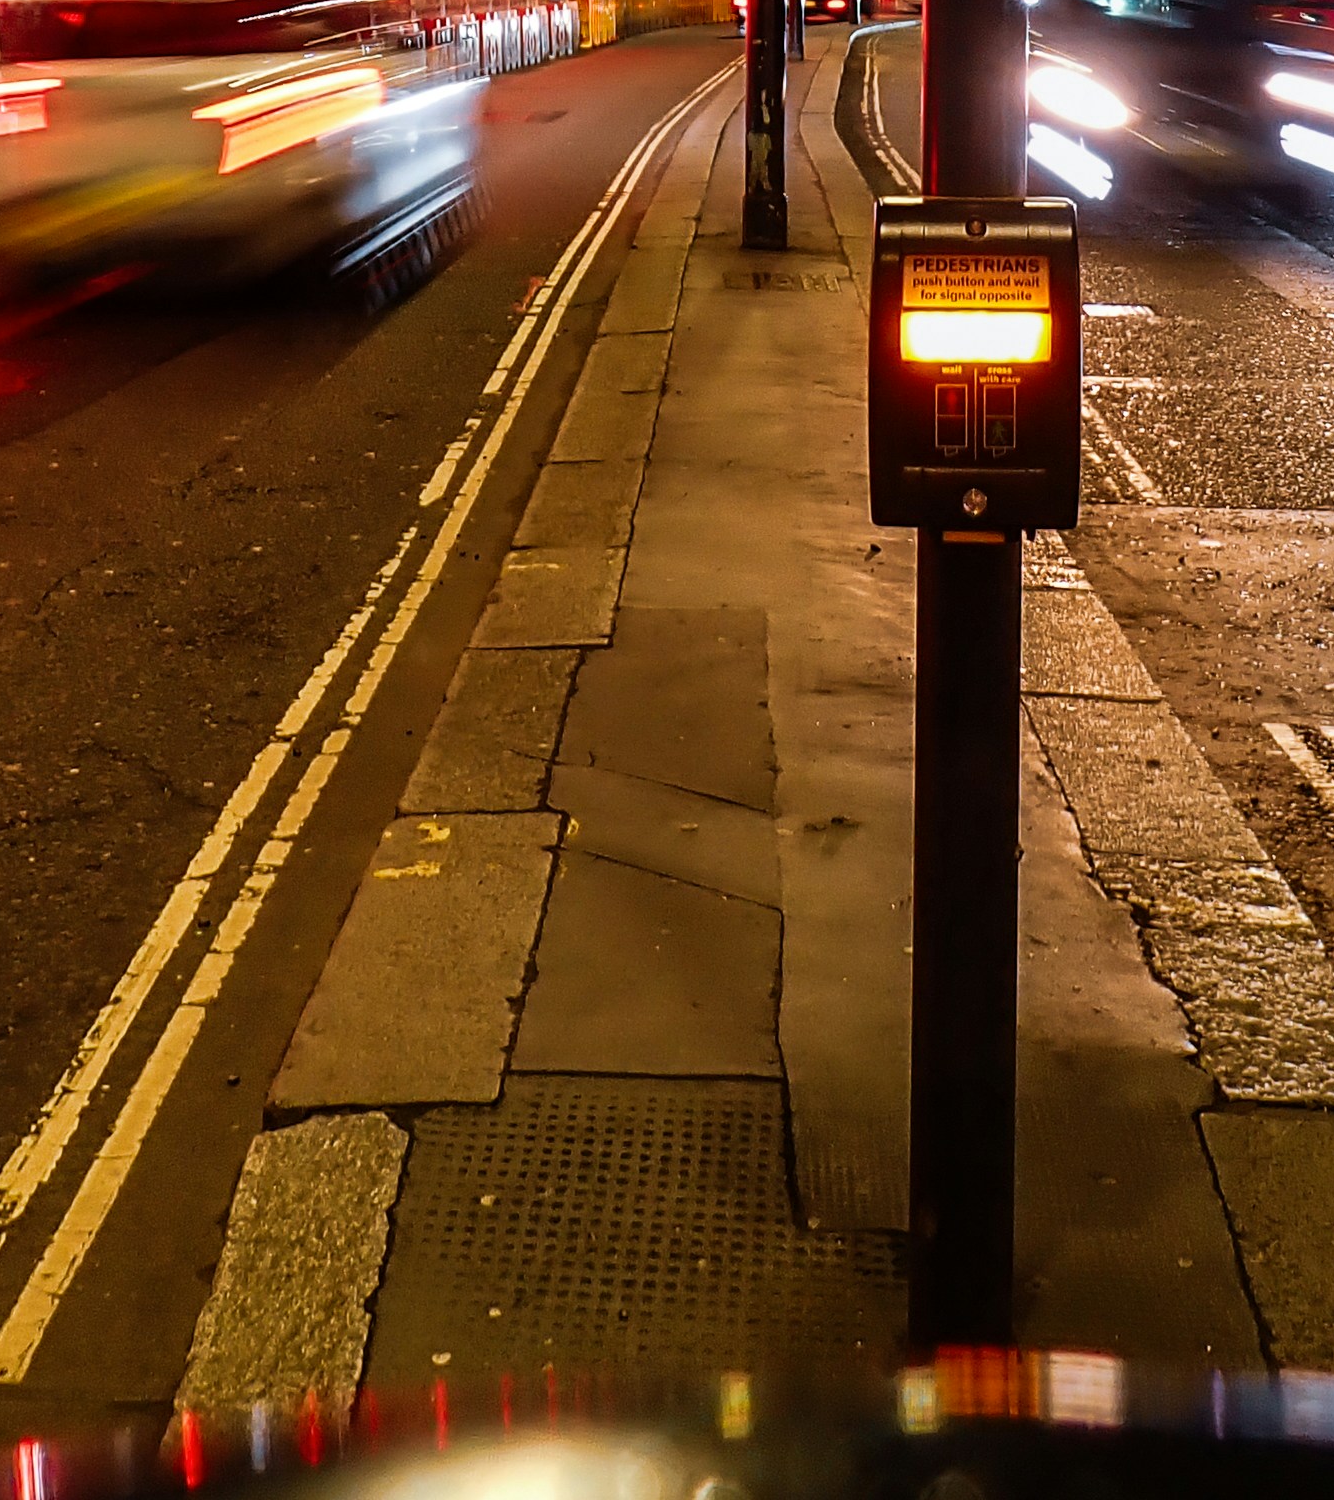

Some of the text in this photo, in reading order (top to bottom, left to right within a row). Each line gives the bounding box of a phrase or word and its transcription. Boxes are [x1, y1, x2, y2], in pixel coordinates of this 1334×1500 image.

[912, 258, 1040, 273] PEDESTRIANS
[912, 275, 1040, 288] push button and wait
[920, 289, 1032, 303] for signal opposite
[942, 365, 962, 374] wait
[979, 375, 999, 383] with
